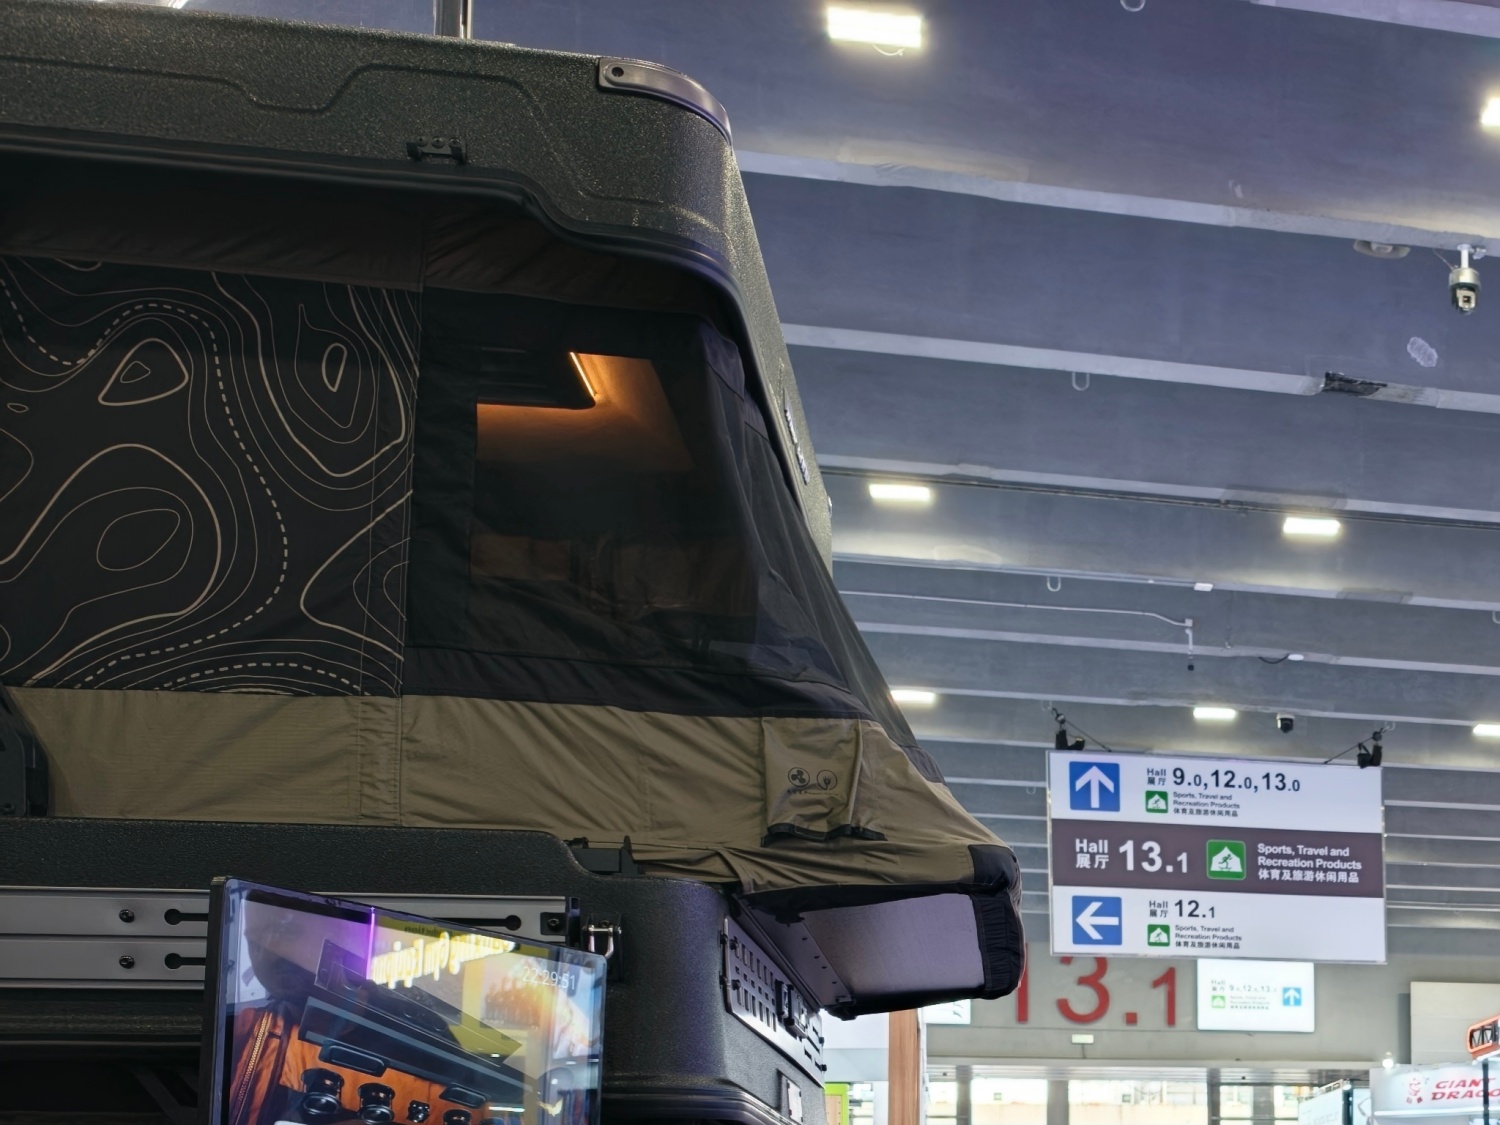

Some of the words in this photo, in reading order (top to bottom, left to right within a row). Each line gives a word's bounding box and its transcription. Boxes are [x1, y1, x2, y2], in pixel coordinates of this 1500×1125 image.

[1146, 768, 1167, 777] Hall
[1172, 800, 1209, 808] Recreation
[1210, 801, 1240, 809] Products
[1075, 838, 1108, 853] Hall
[1118, 839, 1188, 874] 13.1
[1257, 843, 1295, 857] Sports,
[1296, 844, 1328, 856] Travel
[1330, 846, 1350, 857] and
[1075, 853, 1109, 869] 展厅
[1257, 856, 1313, 868] Recreation
[1315, 858, 1362, 870] Products
[1257, 869, 1360, 884] 体育及旅游休闲用品
[1149, 900, 1169, 910] Hall
[1174, 899, 1216, 919] 12.1
[1149, 909, 1169, 918] 展厅
[1175, 925, 1198, 933] Sports,
[1200, 925, 1220, 933] Travel
[1175, 933, 1211, 941] Recreation
[1212, 934, 1242, 942] Products
[521, 965, 577, 991] 22:29:51
